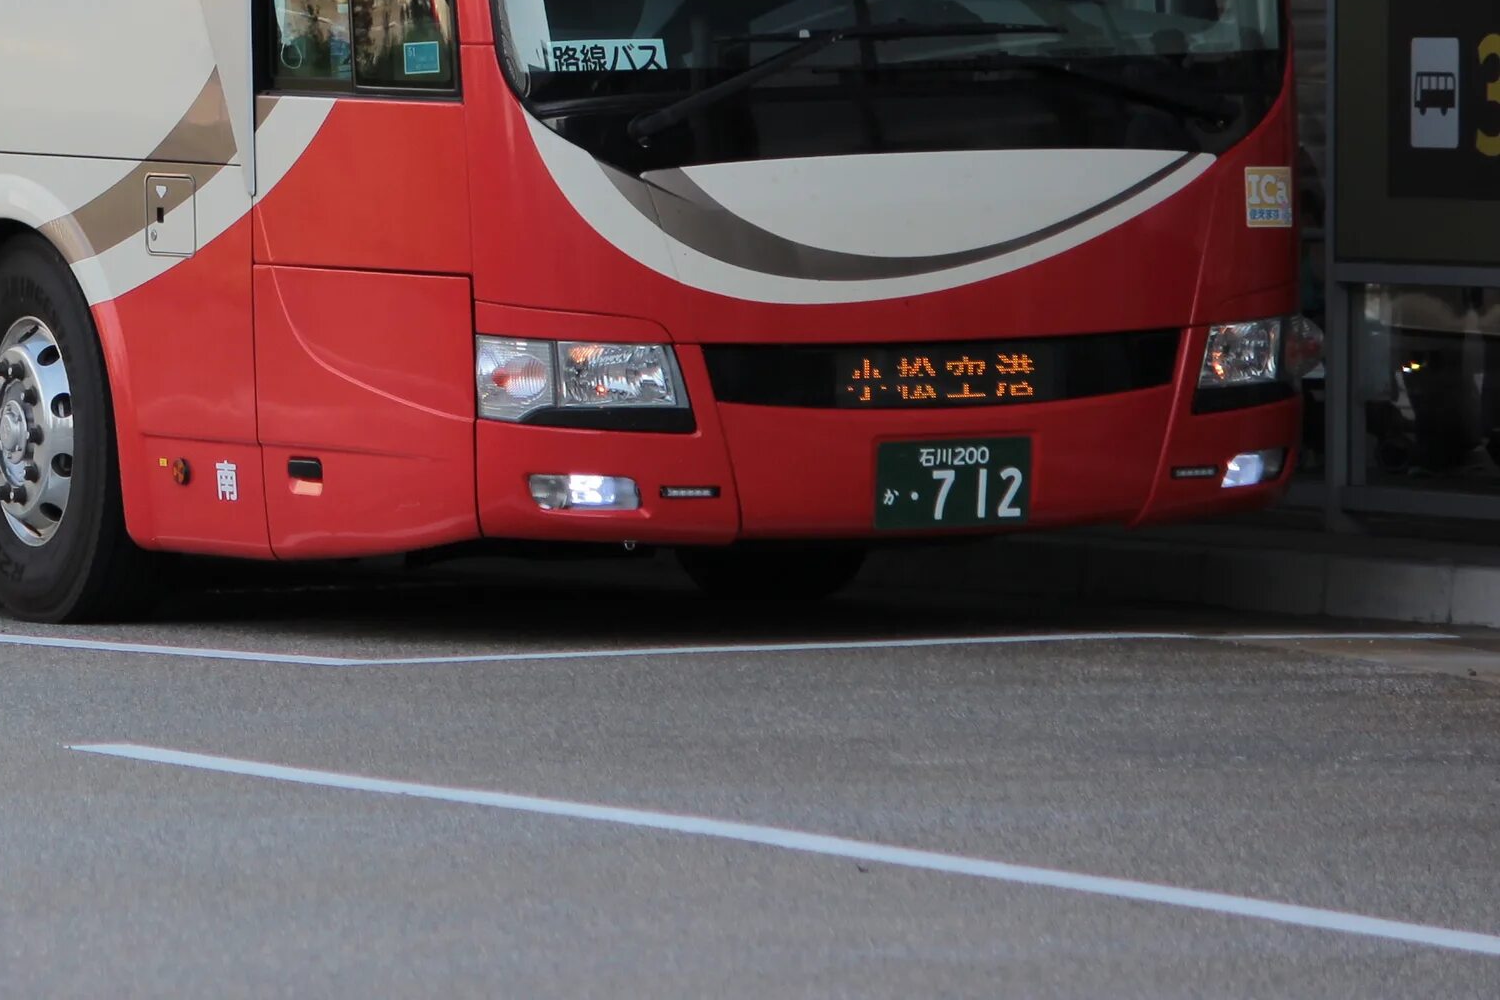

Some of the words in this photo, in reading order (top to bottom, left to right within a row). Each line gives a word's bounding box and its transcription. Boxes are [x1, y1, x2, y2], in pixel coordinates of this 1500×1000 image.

[552, 42, 664, 72] 路線バス
[846, 352, 1036, 402] 小松空港
[214, 459, 240, 502] 南
